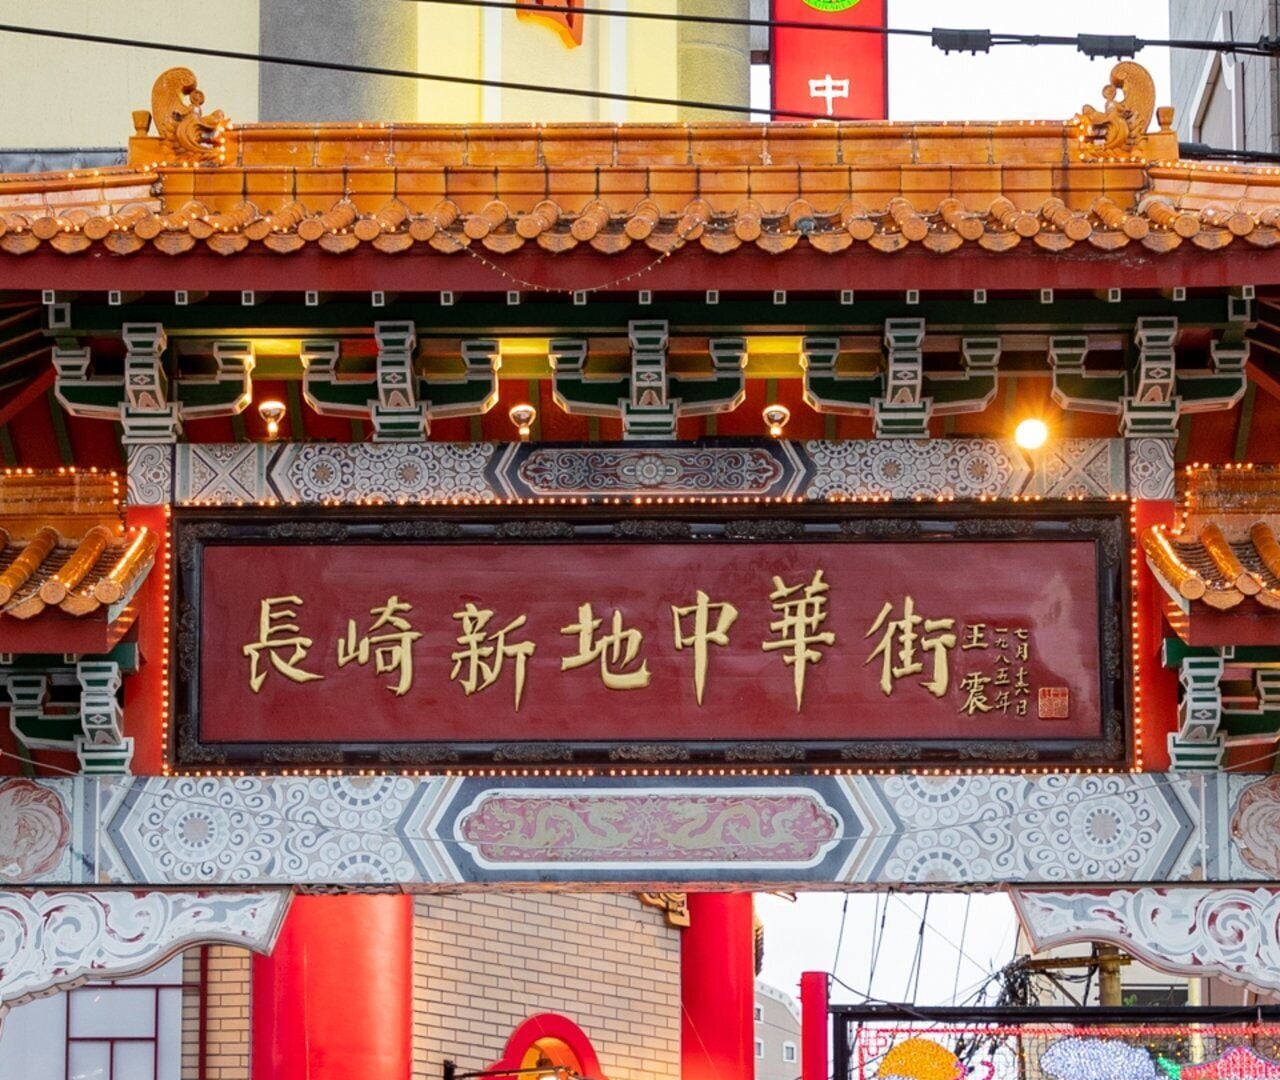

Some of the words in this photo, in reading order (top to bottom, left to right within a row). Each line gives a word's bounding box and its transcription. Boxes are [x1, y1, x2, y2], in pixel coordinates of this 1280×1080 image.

[241, 569, 957, 712] 長崎新地中華街
